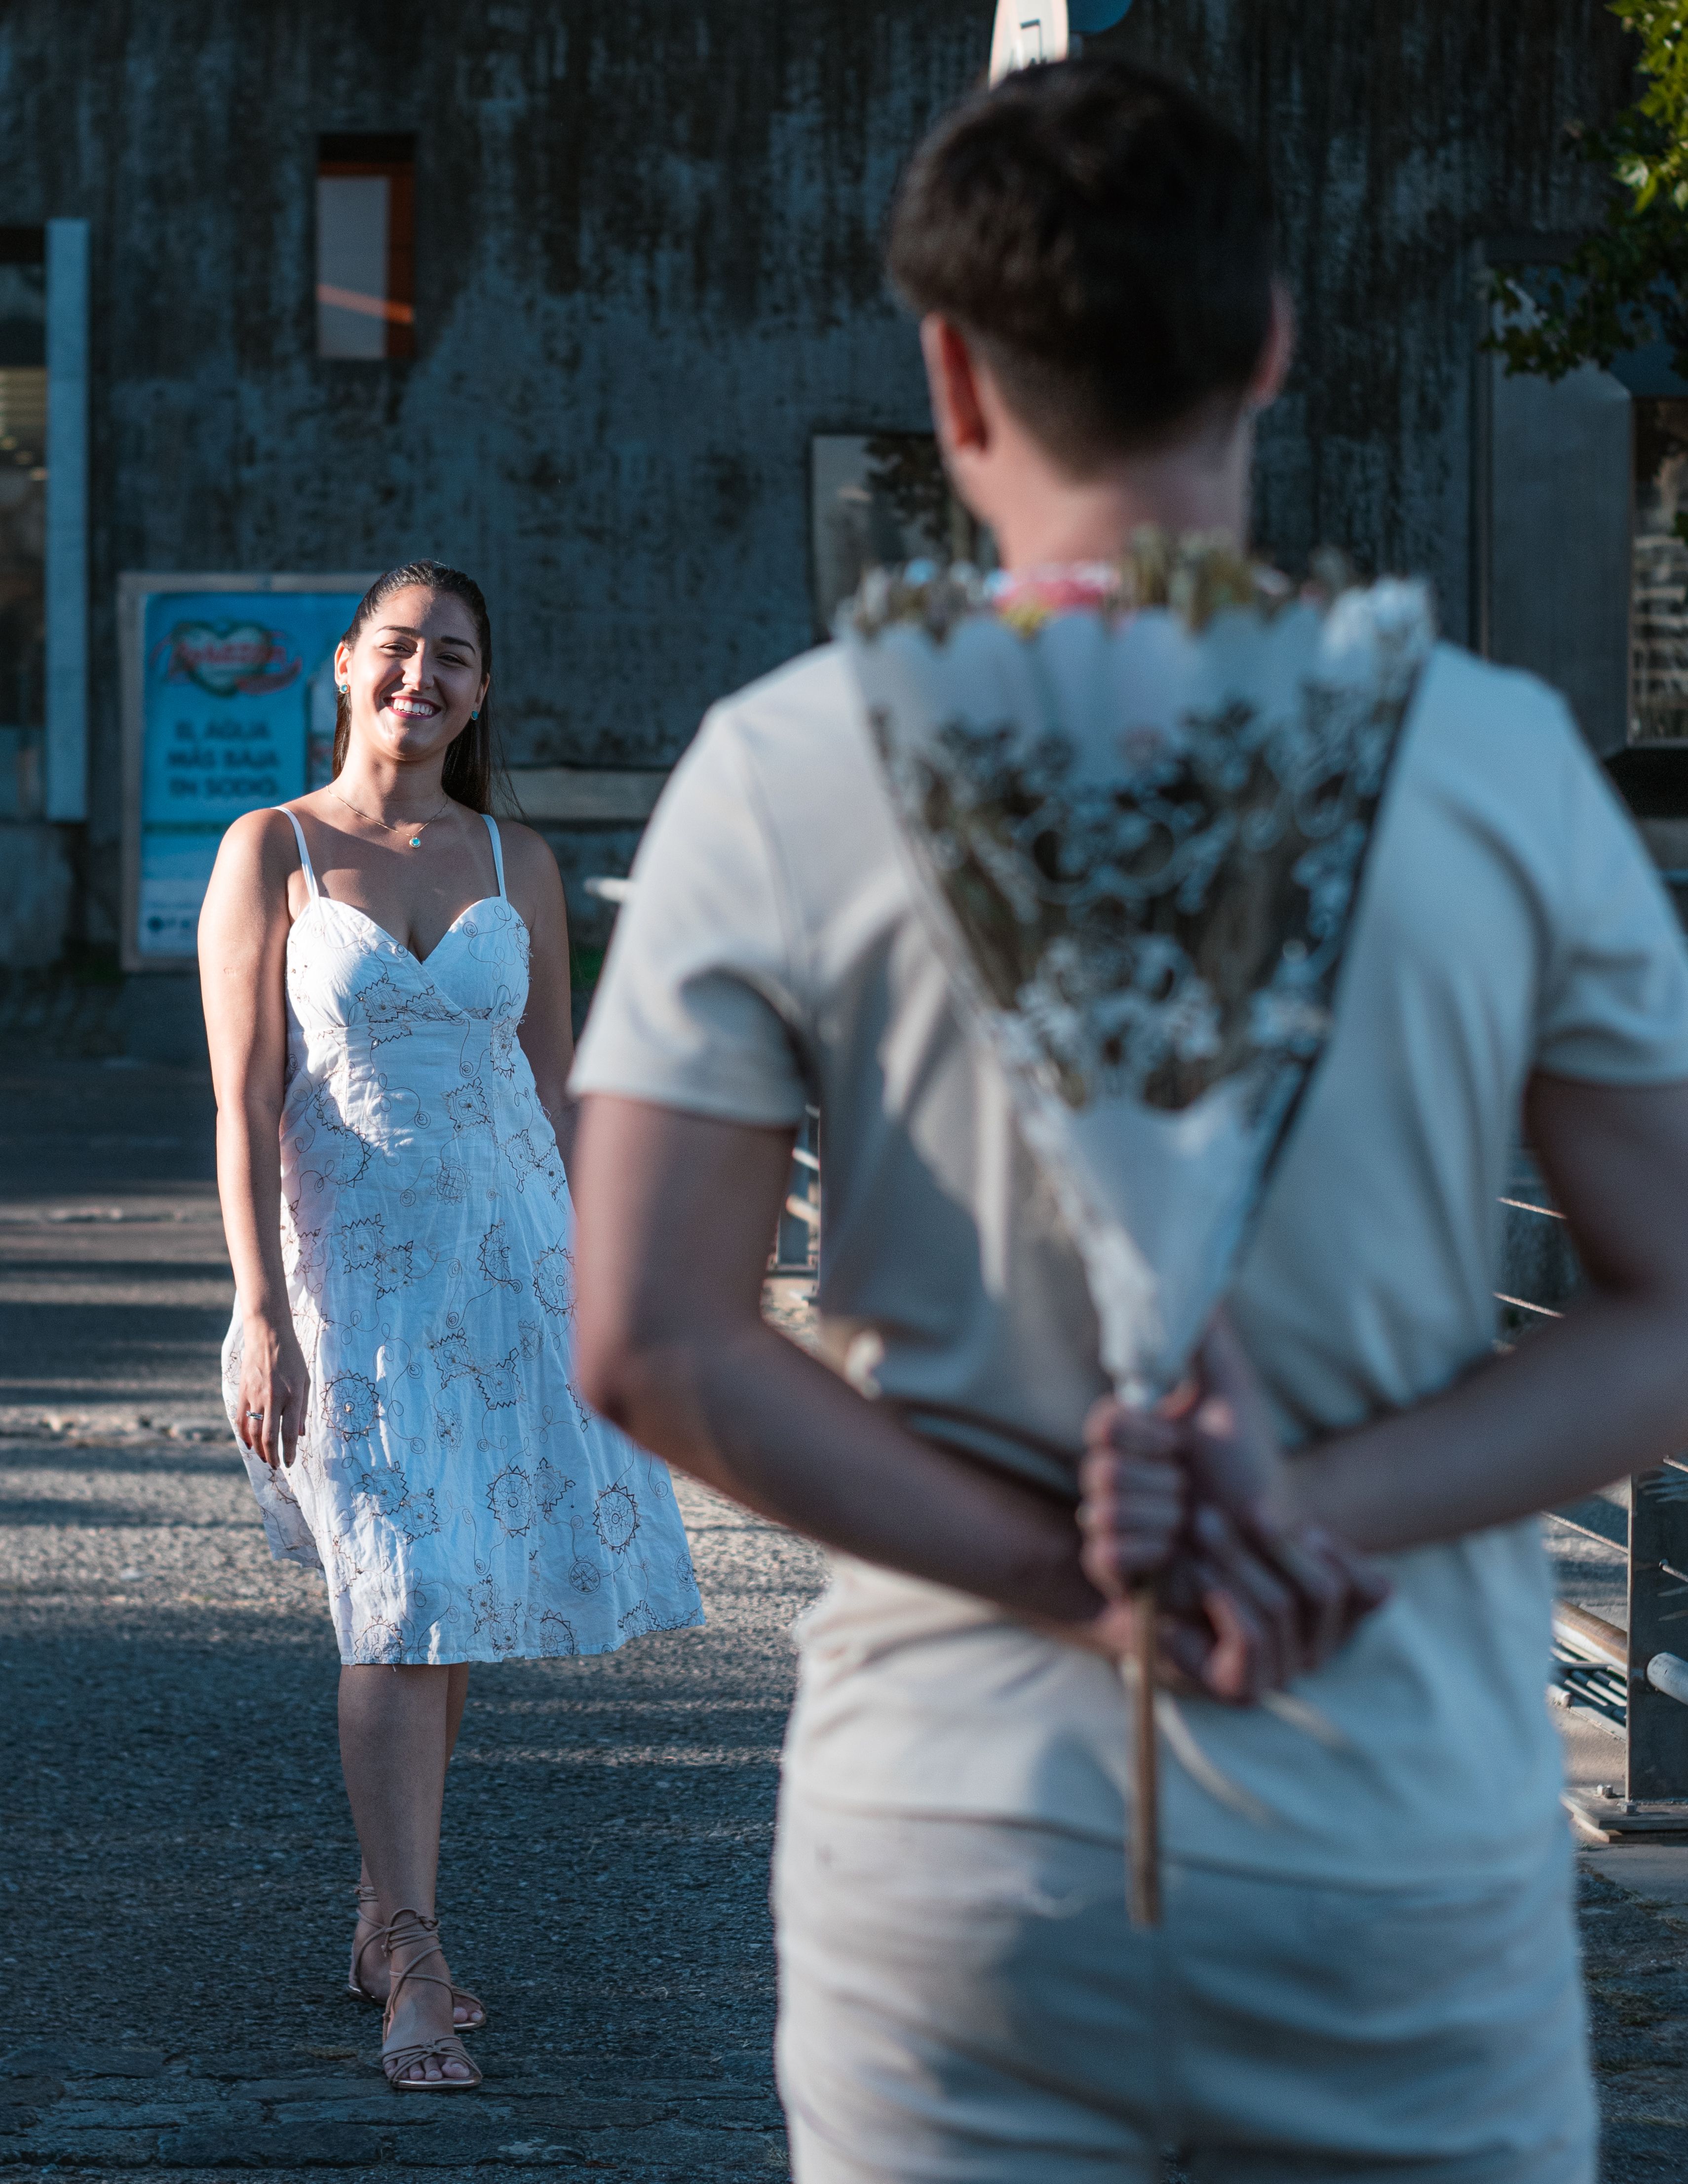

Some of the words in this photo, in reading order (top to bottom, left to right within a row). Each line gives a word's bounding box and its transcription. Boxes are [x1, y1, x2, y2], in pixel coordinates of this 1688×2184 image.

[175, 721, 194, 739] EL
[204, 721, 270, 739] AGUA
[225, 750, 279, 768] BAJA
[169, 778, 197, 796] EN
